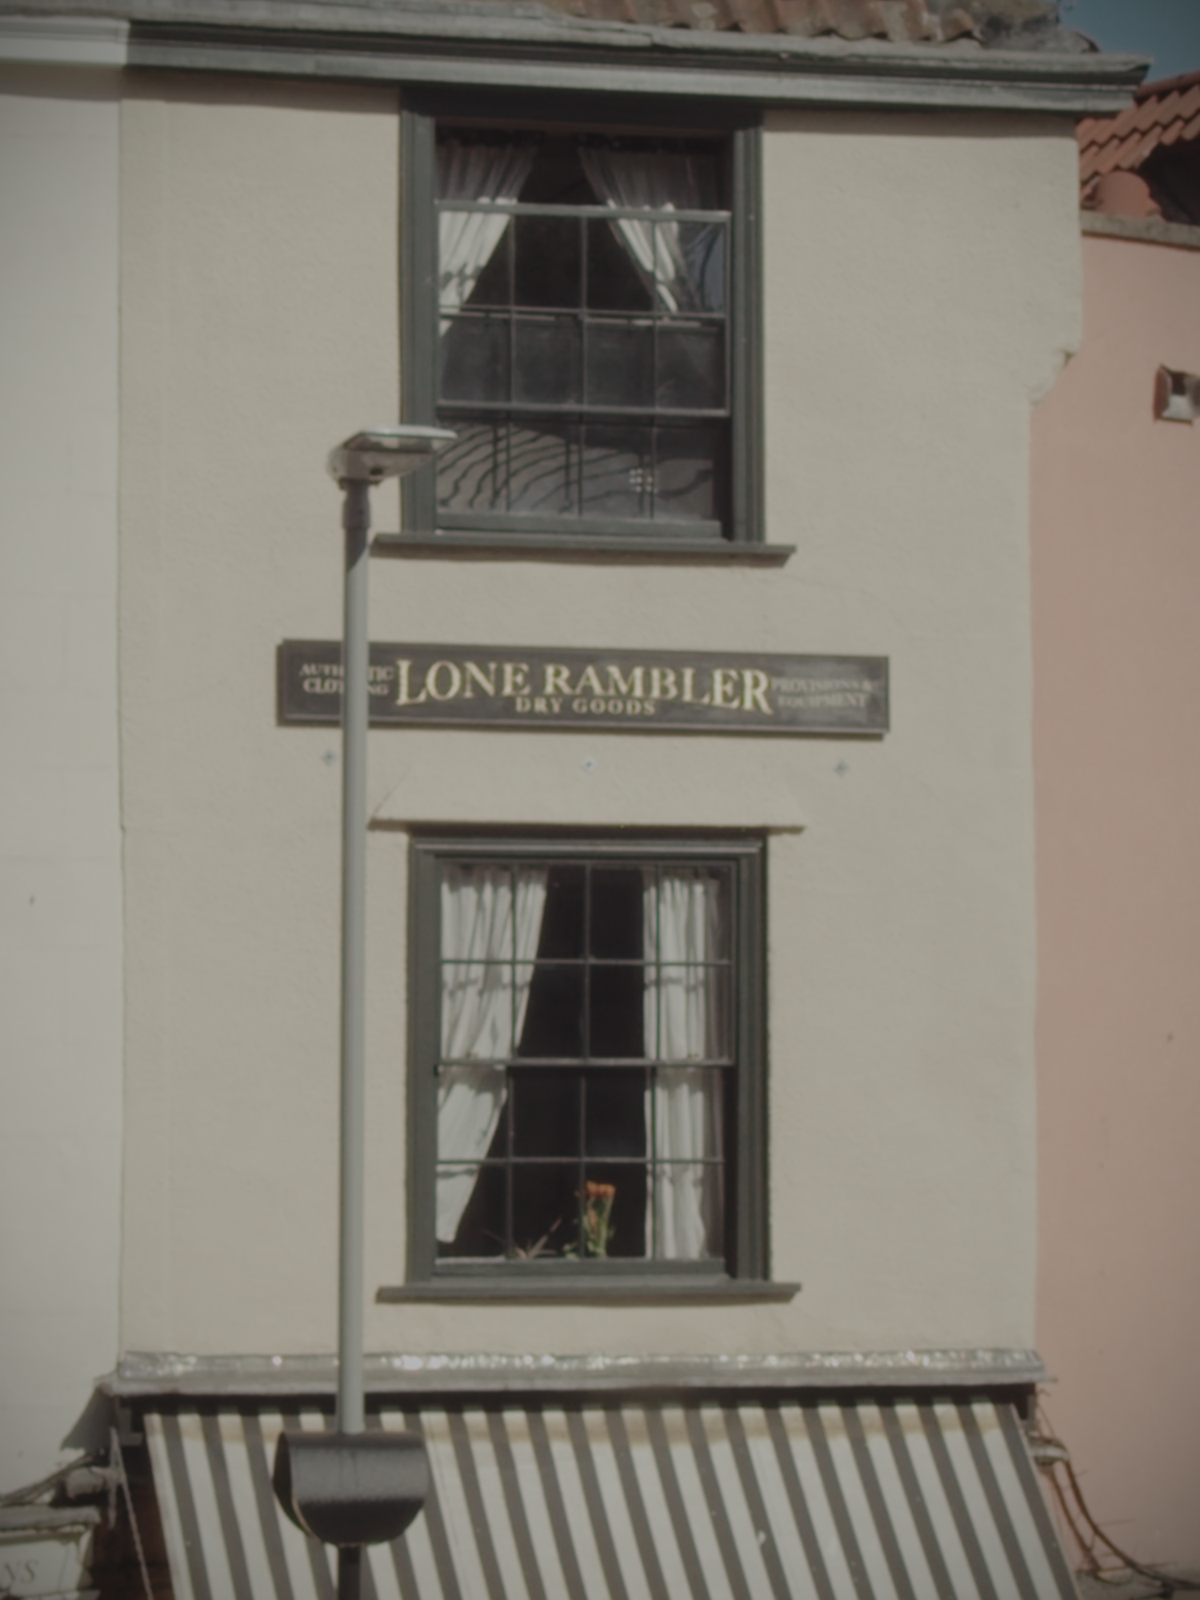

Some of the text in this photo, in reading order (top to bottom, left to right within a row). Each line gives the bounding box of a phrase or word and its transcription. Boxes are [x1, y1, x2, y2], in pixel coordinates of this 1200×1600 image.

[299, 663, 395, 681] AUTHTIC
[303, 678, 389, 696] CLOTNG
[396, 659, 774, 716] LONE RAMBLER
[515, 696, 656, 715] DRY GOODS
